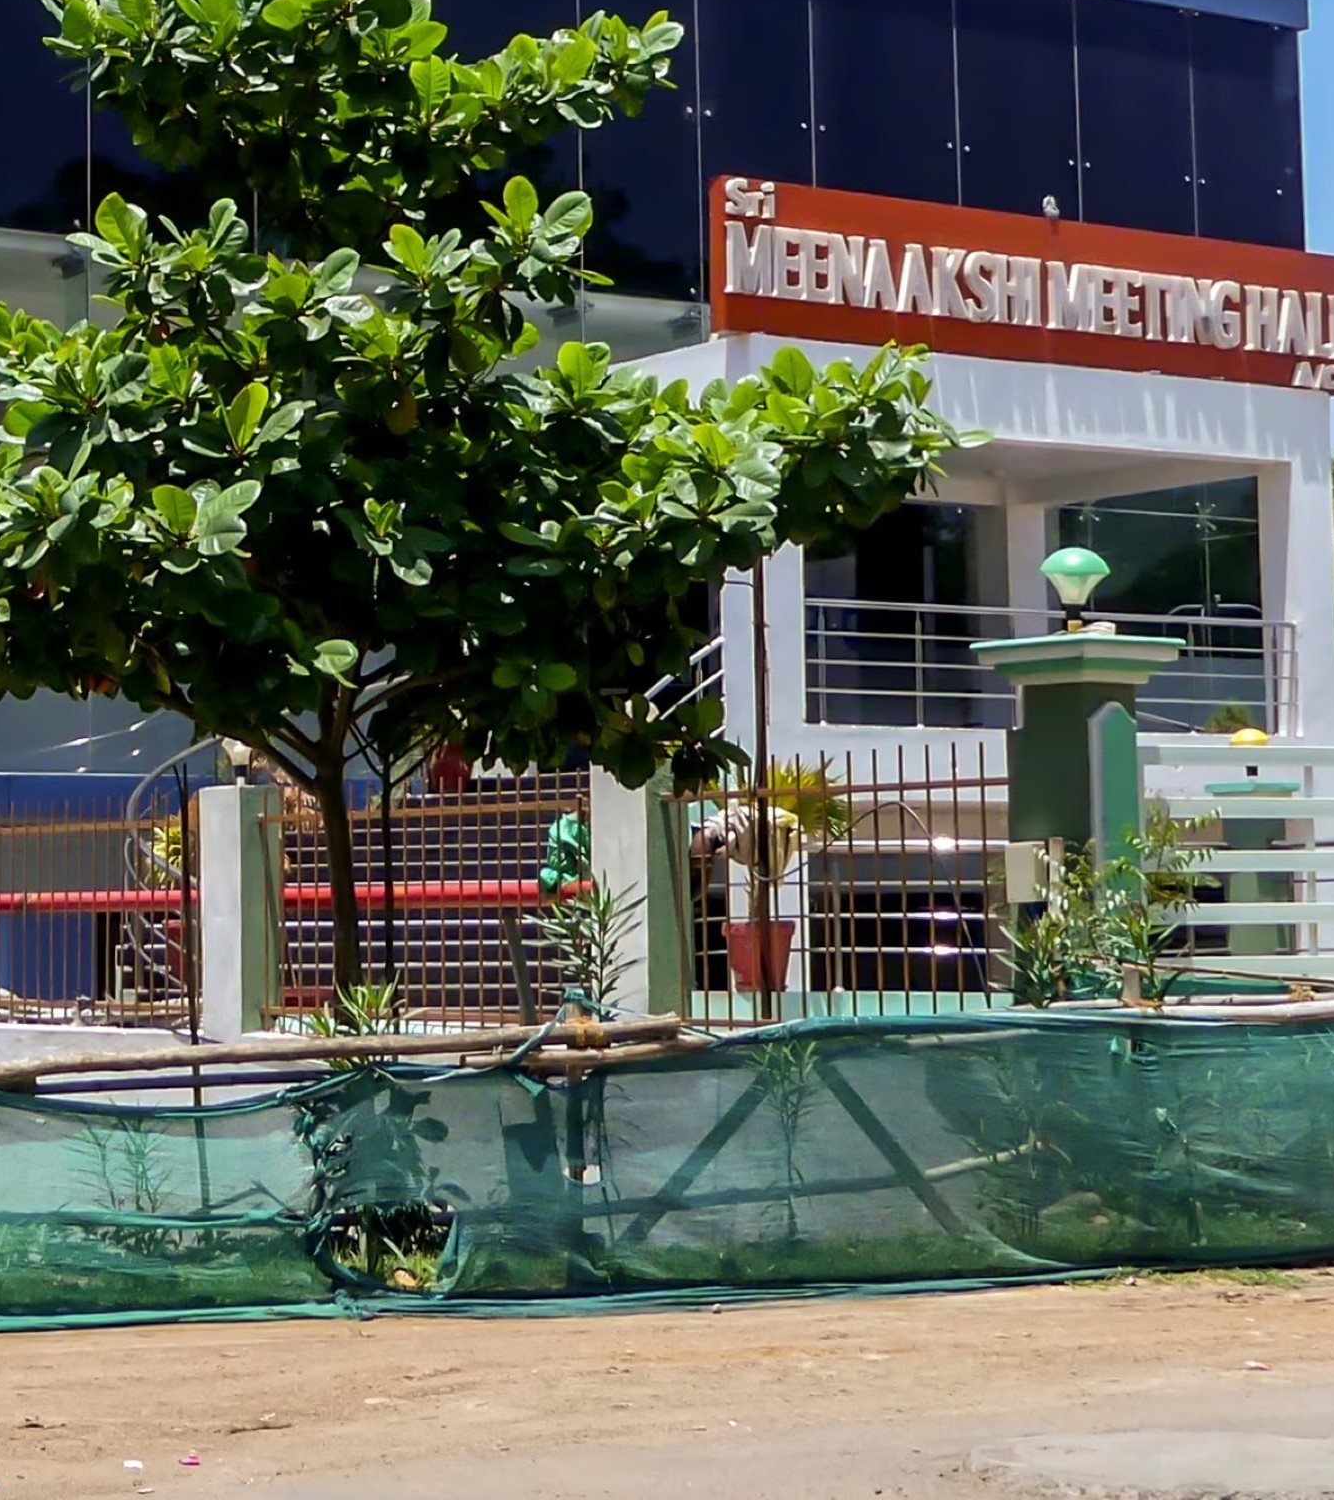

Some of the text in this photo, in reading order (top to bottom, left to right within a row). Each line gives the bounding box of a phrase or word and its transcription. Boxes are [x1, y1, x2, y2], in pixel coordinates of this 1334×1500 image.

[725, 177, 776, 219] Sri
[724, 220, 1043, 329] MEENAAKSHI
[1045, 260, 1242, 350] MEETING
